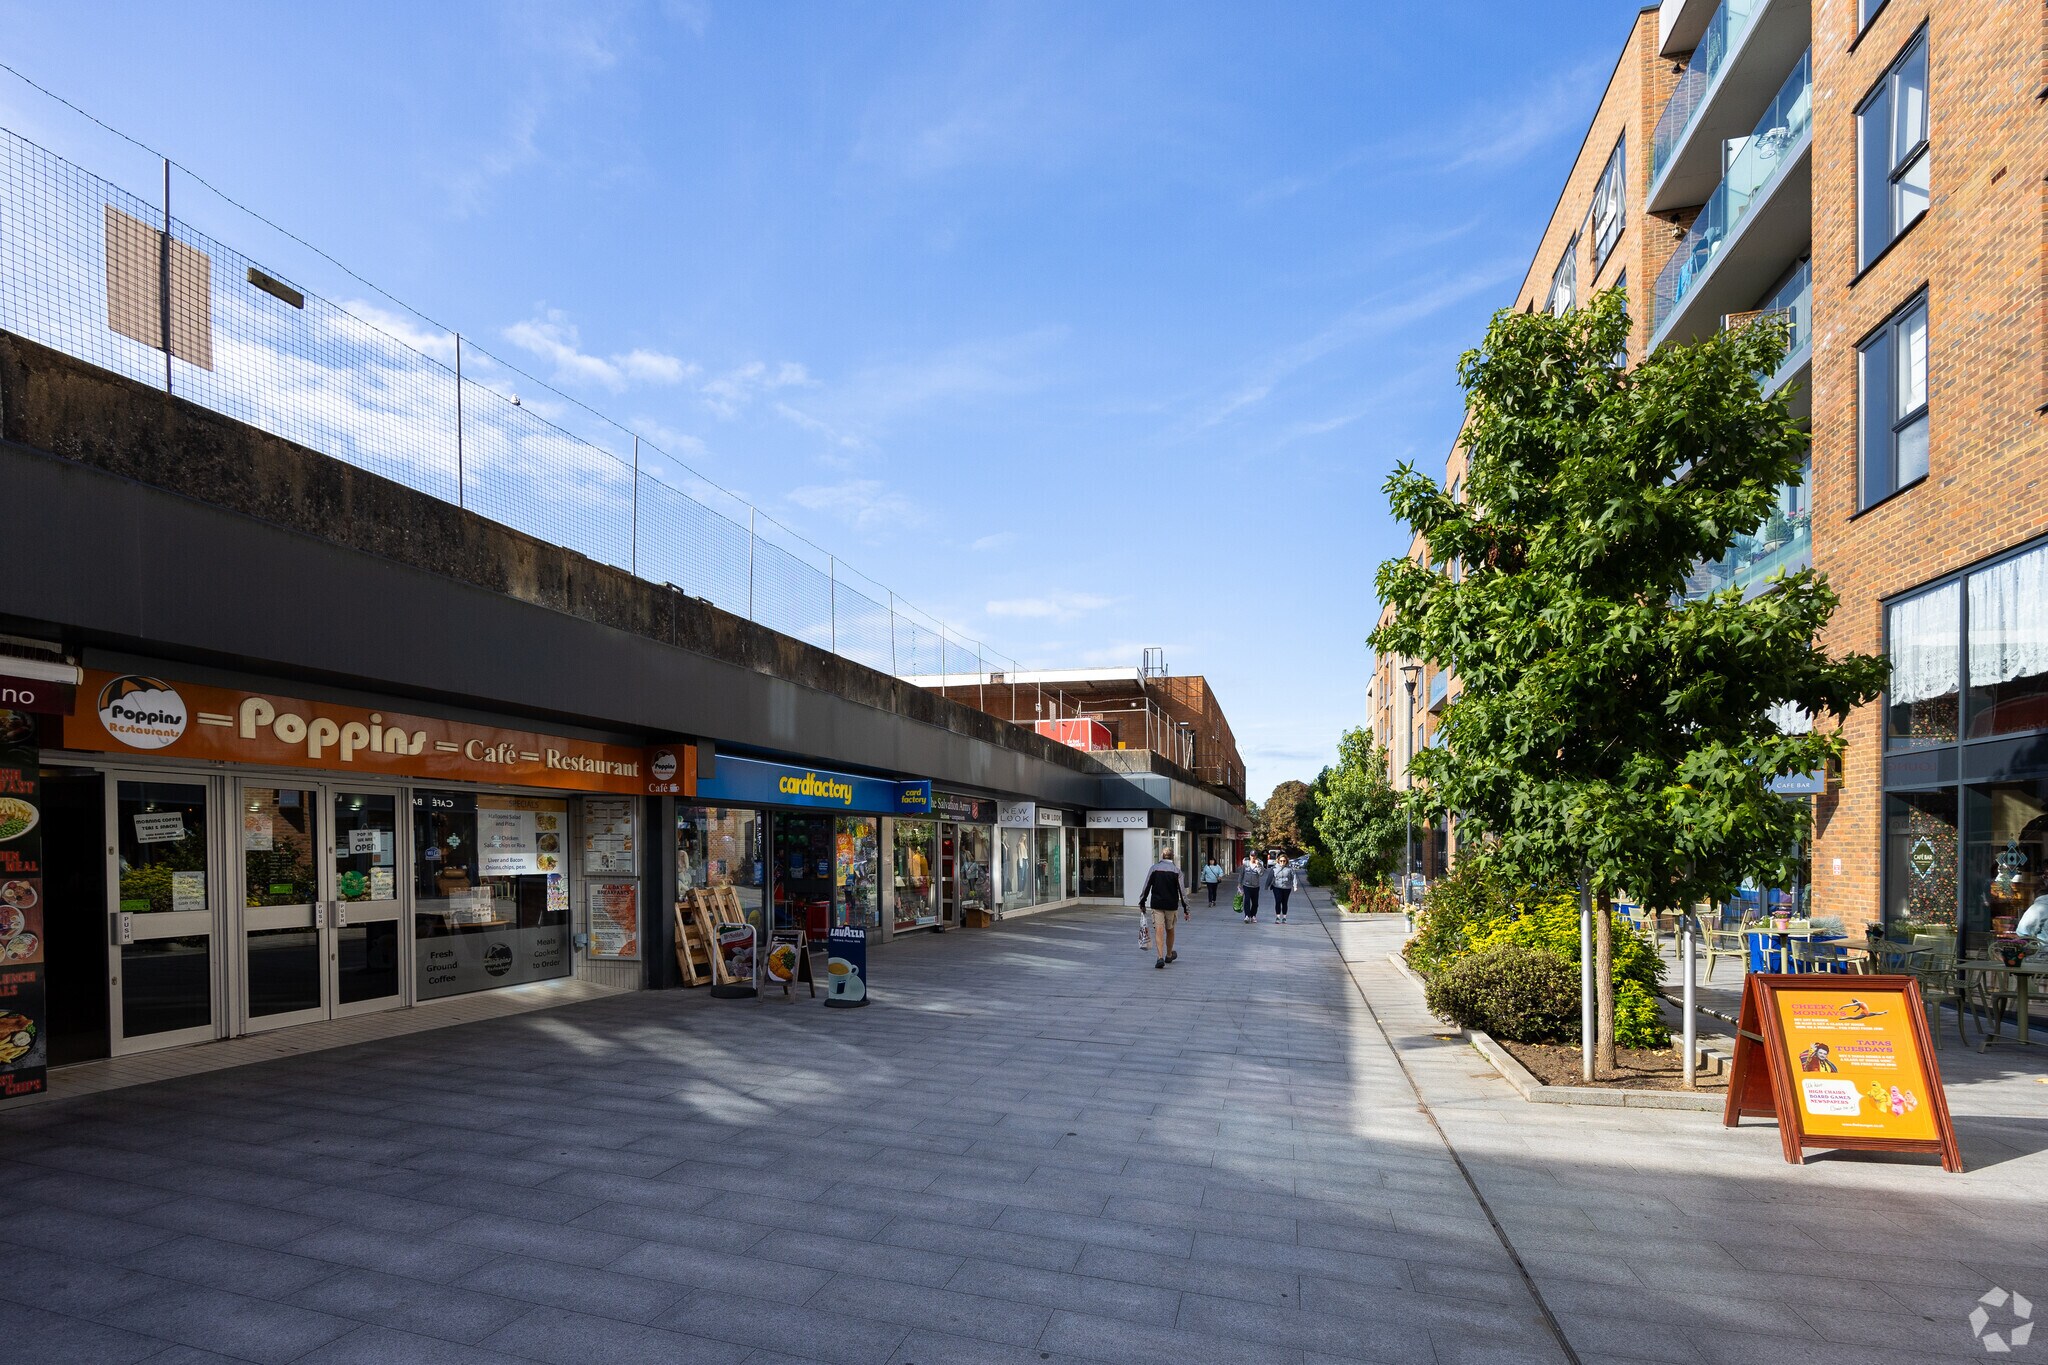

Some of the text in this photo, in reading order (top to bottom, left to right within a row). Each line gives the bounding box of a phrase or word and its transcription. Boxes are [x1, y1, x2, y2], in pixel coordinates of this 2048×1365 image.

[112, 705, 181, 725] Poppins
[109, 723, 179, 738] Restaurants
[239, 697, 639, 778] Poppins Café Restaurant
[649, 783, 668, 792] Café
[779, 772, 852, 805] cardfactory
[905, 788, 921, 796] card
[508, 800, 540, 808] SPECIALS
[901, 796, 927, 804] factory
[938, 798, 959, 811] Salvation
[960, 801, 971, 814] Army
[1051, 813, 1062, 821] LOOK
[830, 926, 864, 938] LAVAZZA
[536, 938, 556, 946] Meals
[430, 950, 453, 959] Fresh
[534, 948, 559, 957] Cooked
[426, 961, 458, 972] Ground
[542, 960, 560, 968] Order
[428, 974, 456, 984] Coffee
